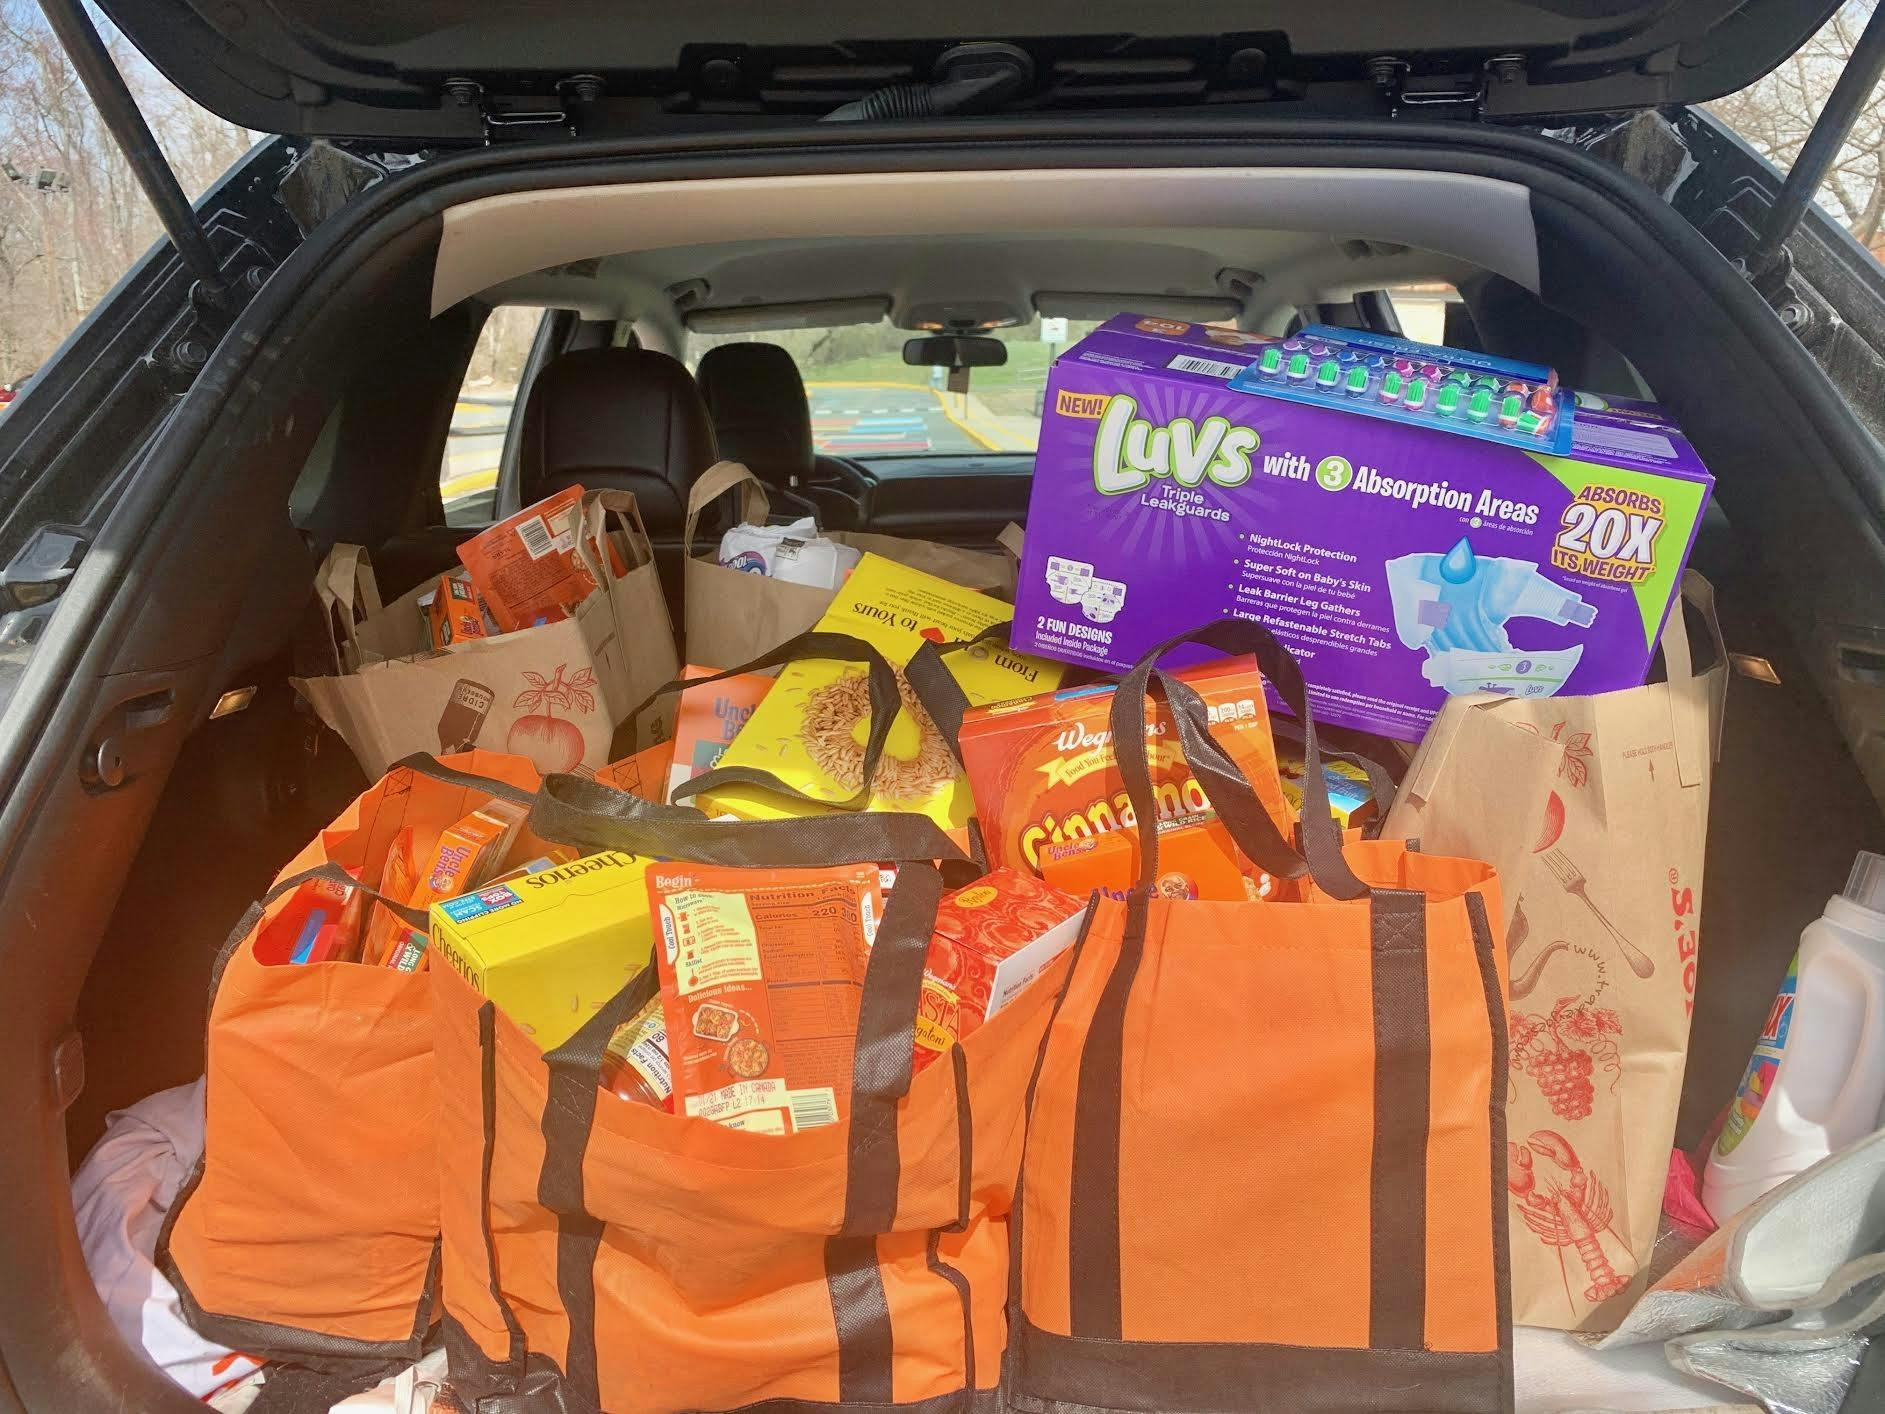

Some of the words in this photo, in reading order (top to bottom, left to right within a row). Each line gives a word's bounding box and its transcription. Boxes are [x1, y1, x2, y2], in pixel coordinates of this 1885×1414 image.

[1059, 395, 1103, 416] NEW!
[1094, 394, 1261, 495] Luvs
[1161, 485, 1204, 505] Triple
[1263, 452, 1310, 481] with
[1353, 466, 1472, 513] Absorption
[1475, 488, 1540, 525] Areas
[1141, 493, 1230, 523] Leakguards
[1577, 486, 1663, 514] ABSORBS
[1459, 516, 1470, 525] con
[1499, 522, 1507, 531] de
[1558, 503, 1663, 564] 20X
[1247, 545, 1283, 559] Protección
[1284, 553, 1320, 566] NightLock
[1250, 533, 1301, 551] NightLock
[1303, 543, 1358, 563] Protection
[1552, 550, 1579, 571] ITS
[1242, 570, 1282, 585] Supersuave
[1282, 579, 1295, 588] con
[1296, 581, 1303, 589] la
[1303, 582, 1317, 593] piel
[1318, 585, 1327, 594] de
[1328, 588, 1337, 596] tu
[1338, 589, 1356, 600] bebé
[1244, 559, 1274, 574] Super
[1275, 565, 1297, 579] Soft
[1298, 571, 1312, 582] on
[1314, 573, 1346, 591] Baby's
[1348, 579, 1371, 593] Skin
[1239, 584, 1263, 596] Leak
[1264, 588, 1298, 604] Barrier
[1299, 596, 1319, 610] Leg
[1320, 600, 1361, 618] Gathers
[853, 602, 897, 628] Yours
[901, 617, 918, 632] to
[1236, 595, 1266, 608] Barreras
[1266, 601, 1278, 610] que
[1279, 603, 1311, 619] protegen
[1312, 610, 1319, 619] la
[1319, 612, 1333, 623] piel
[1334, 615, 1356, 627] contra
[1356, 619, 1390, 634] derrames
[1037, 615, 1046, 629] 2
[1047, 617, 1067, 635] FUN
[1068, 622, 1113, 645] DESIGNS
[1262, 614, 1328, 636] Refastenable
[1330, 628, 1366, 645] Stretch
[1368, 636, 1392, 650] Tabs
[1035, 630, 1062, 645] Included
[1062, 636, 1082, 650] Inside
[1083, 640, 1109, 656] Package
[1300, 633, 1348, 652] desprendibles
[1349, 644, 1378, 657] grandes
[995, 654, 1040, 684] From
[457, 693, 485, 709] CIDRE
[1065, 763, 1084, 778] Food
[1085, 756, 1099, 769] You
[1048, 842, 1080, 855] Uncle
[450, 845, 472, 878] Uncle
[526, 850, 639, 889] Cheerios
[656, 875, 693, 889] Begin
[750, 891, 815, 901] Nutrition
[821, 884, 857, 896] Facts
[490, 903, 511, 914] MORE
[511, 899, 524, 907] NO
[674, 894, 690, 905] How
[456, 910, 490, 925] CLIPPING
[755, 912, 799, 921] Calories
[812, 906, 837, 917] 220
[863, 904, 872, 922] Touch
[663, 916, 673, 936] Touch
[866, 921, 875, 938] Cool
[667, 936, 676, 950] Cool
[408, 949, 421, 969] LONG
[431, 922, 481, 991] Cheerios
[688, 985, 722, 1004] Delicious
[921, 988, 960, 1040] STA
[914, 1026, 946, 1047] gatoni
[630, 1048, 649, 1064] Facts
[647, 1063, 673, 1095] Nutrition
[720, 1086, 736, 1101] MADE
[739, 1081, 749, 1096] IN
[751, 1080, 777, 1093] CANADA
[728, 1119, 746, 1130] know
